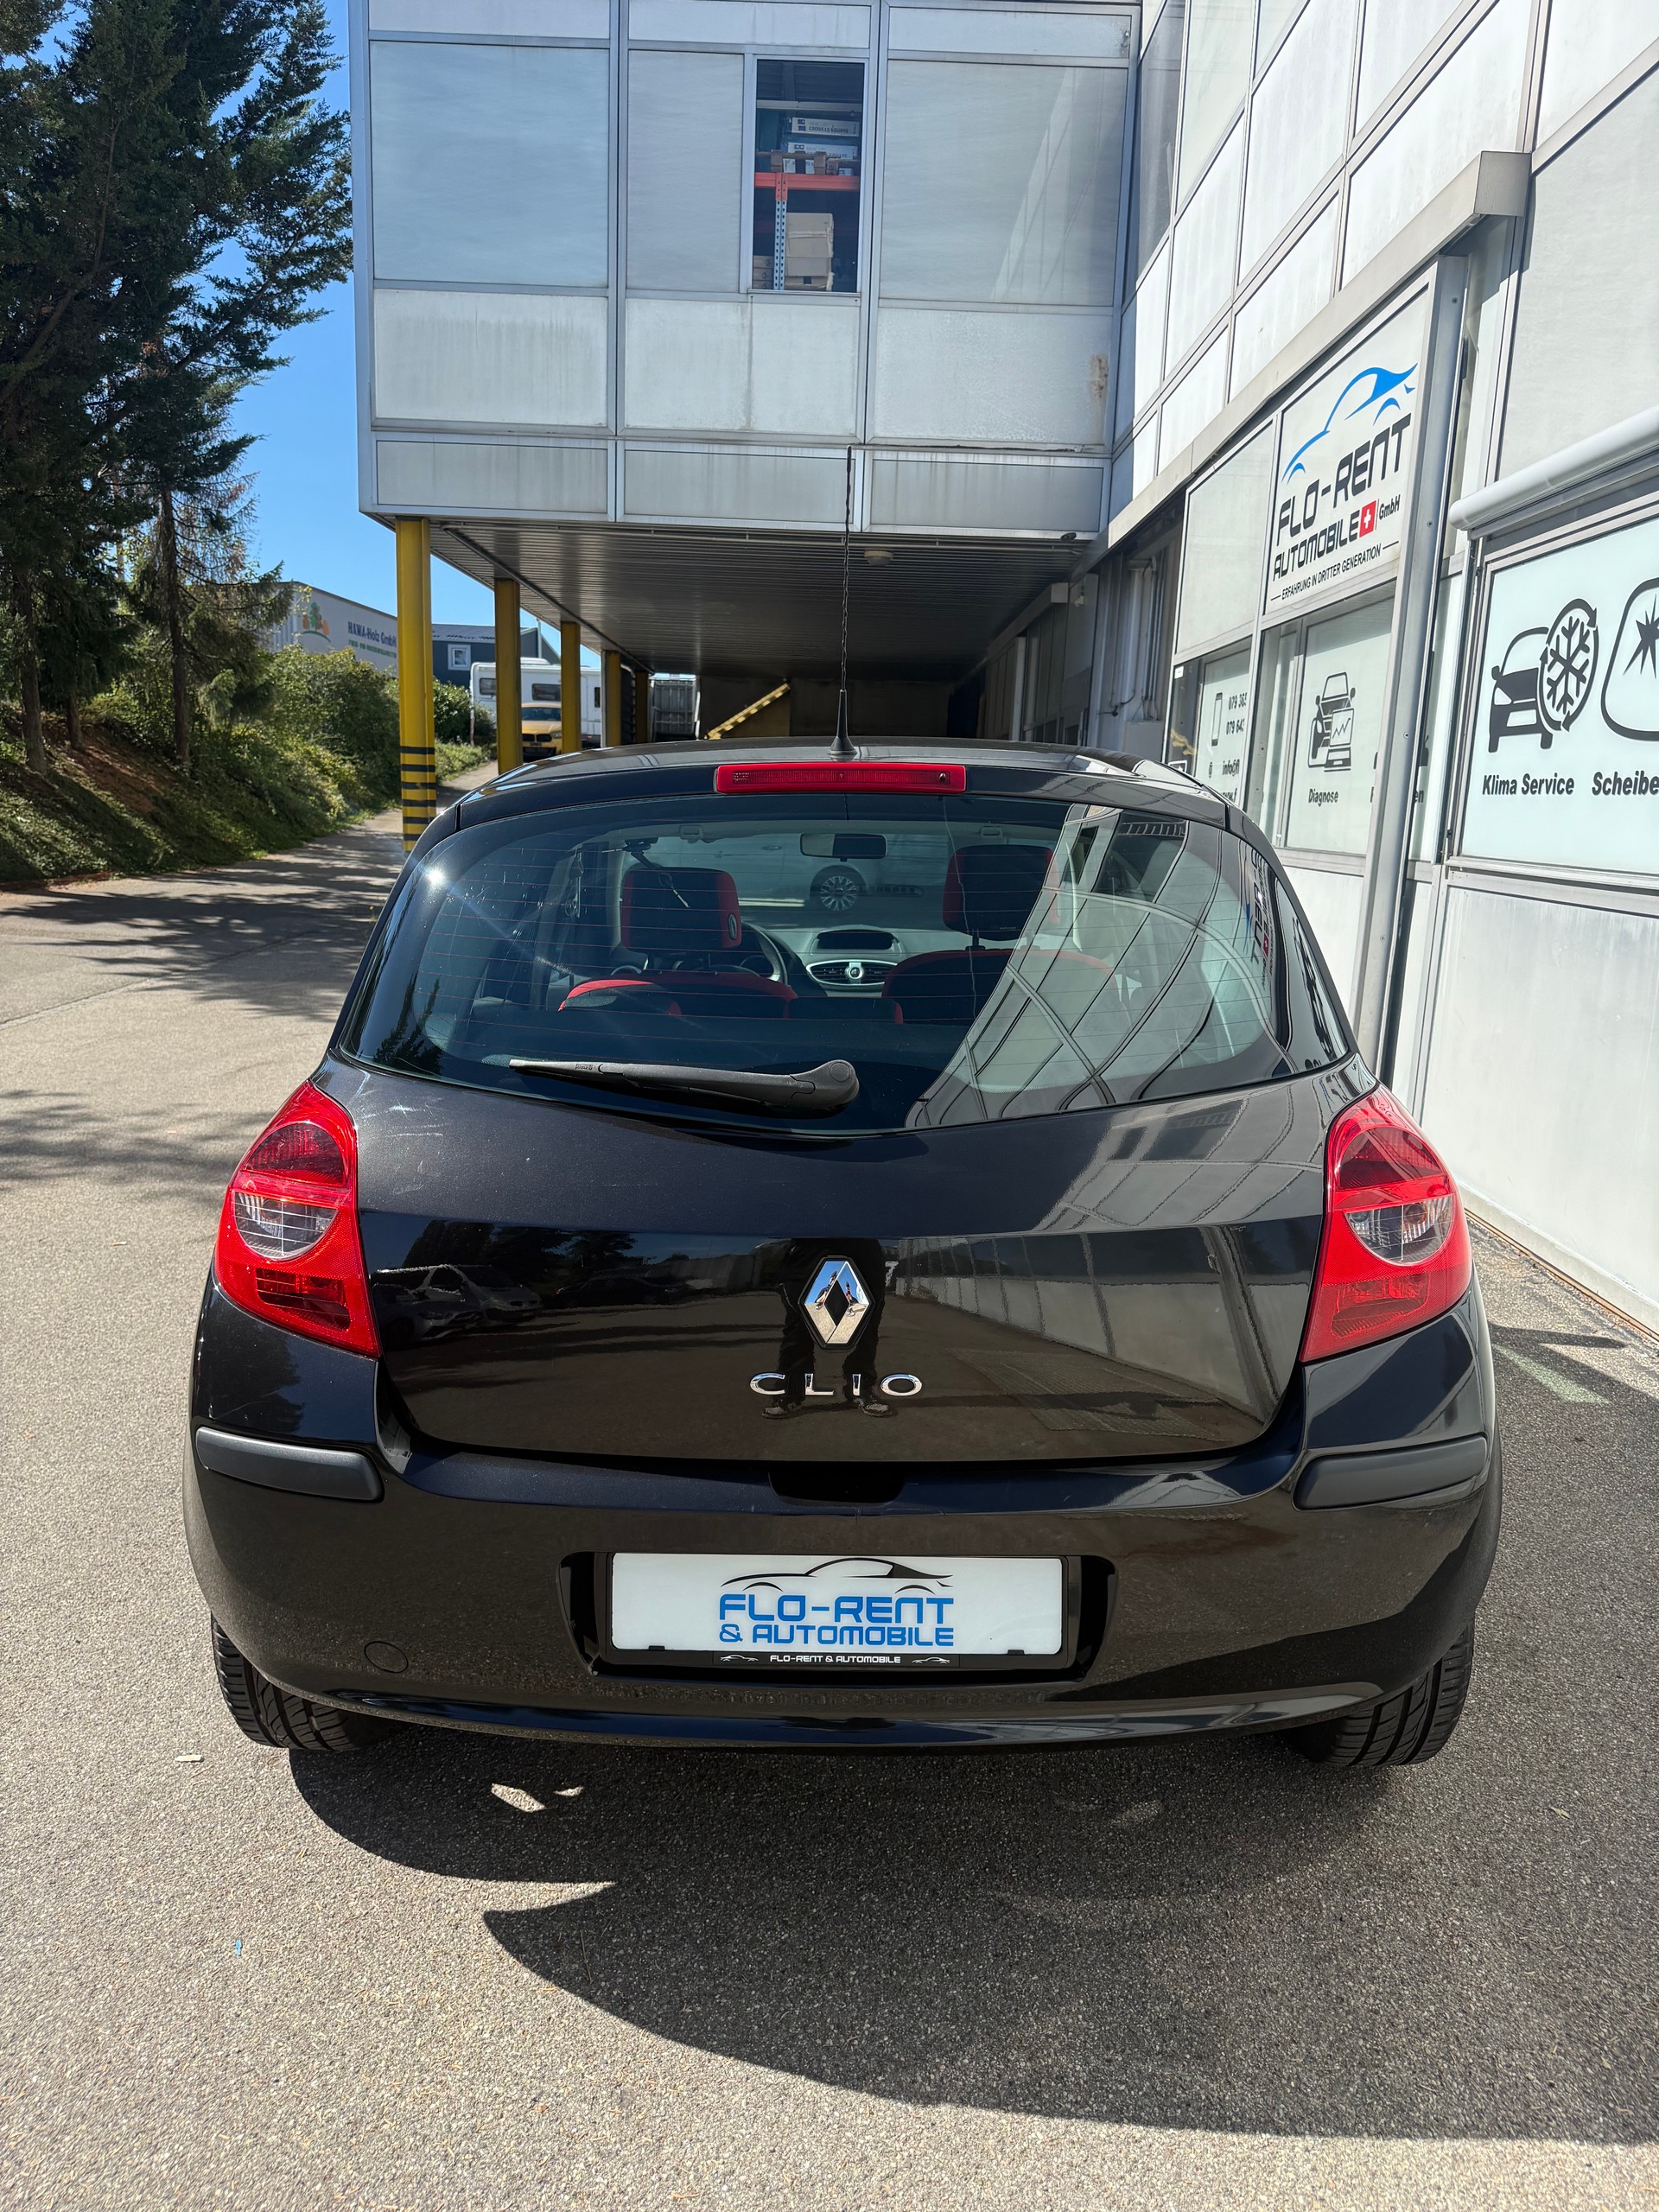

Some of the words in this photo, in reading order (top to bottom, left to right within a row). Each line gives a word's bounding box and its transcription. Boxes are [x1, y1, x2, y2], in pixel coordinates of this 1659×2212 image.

[1277, 412, 1411, 547] FLO-RENT
[1273, 509, 1360, 582] AUTOMOBILE
[1378, 494, 1402, 521] GmbH
[1281, 576, 1312, 601] ERFAHRUNG
[1311, 574, 1318, 587] IN
[1318, 564, 1341, 584] DRITTER
[1341, 543, 1382, 574] GENERATION
[1228, 695, 1238, 711] 079
[1225, 721, 1236, 735] 079
[1482, 773, 1517, 796] Klima
[1521, 772, 1575, 796] Service
[1592, 770, 1659, 797] Scheibe
[1307, 787, 1339, 808] Diagnose
[749, 1372, 923, 1397] CLIO
[719, 1593, 954, 1624] FLO-RENT
[719, 1624, 743, 1643] &
[751, 1624, 954, 1647] AUTOMOBILE
[770, 1655, 824, 1663] FLO-RENT
[825, 1655, 835, 1663] &
[836, 1655, 901, 1664] AUTOMOBILE
